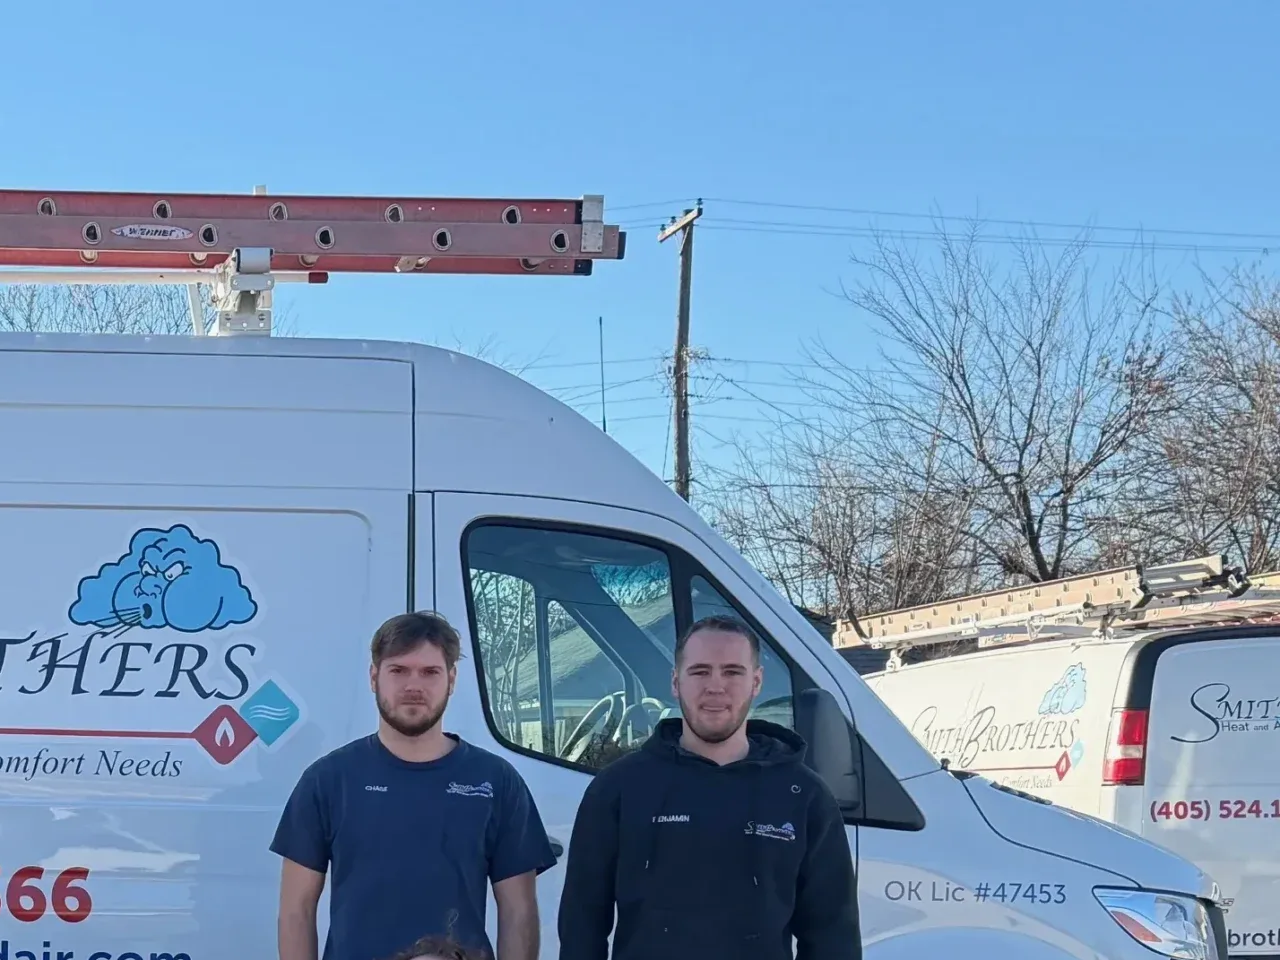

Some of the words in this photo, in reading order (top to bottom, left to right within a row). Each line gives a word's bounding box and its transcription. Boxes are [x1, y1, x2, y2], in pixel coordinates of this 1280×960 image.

[1170, 683, 1280, 743] SMIT
[1221, 720, 1250, 732] Heat
[958, 706, 1080, 768] BROTHERS
[94, 750, 183, 779] Needs
[1150, 800, 1211, 822] (405)
[885, 881, 922, 901] OK
[931, 881, 965, 902] Lic
[973, 882, 1067, 904] #47453
